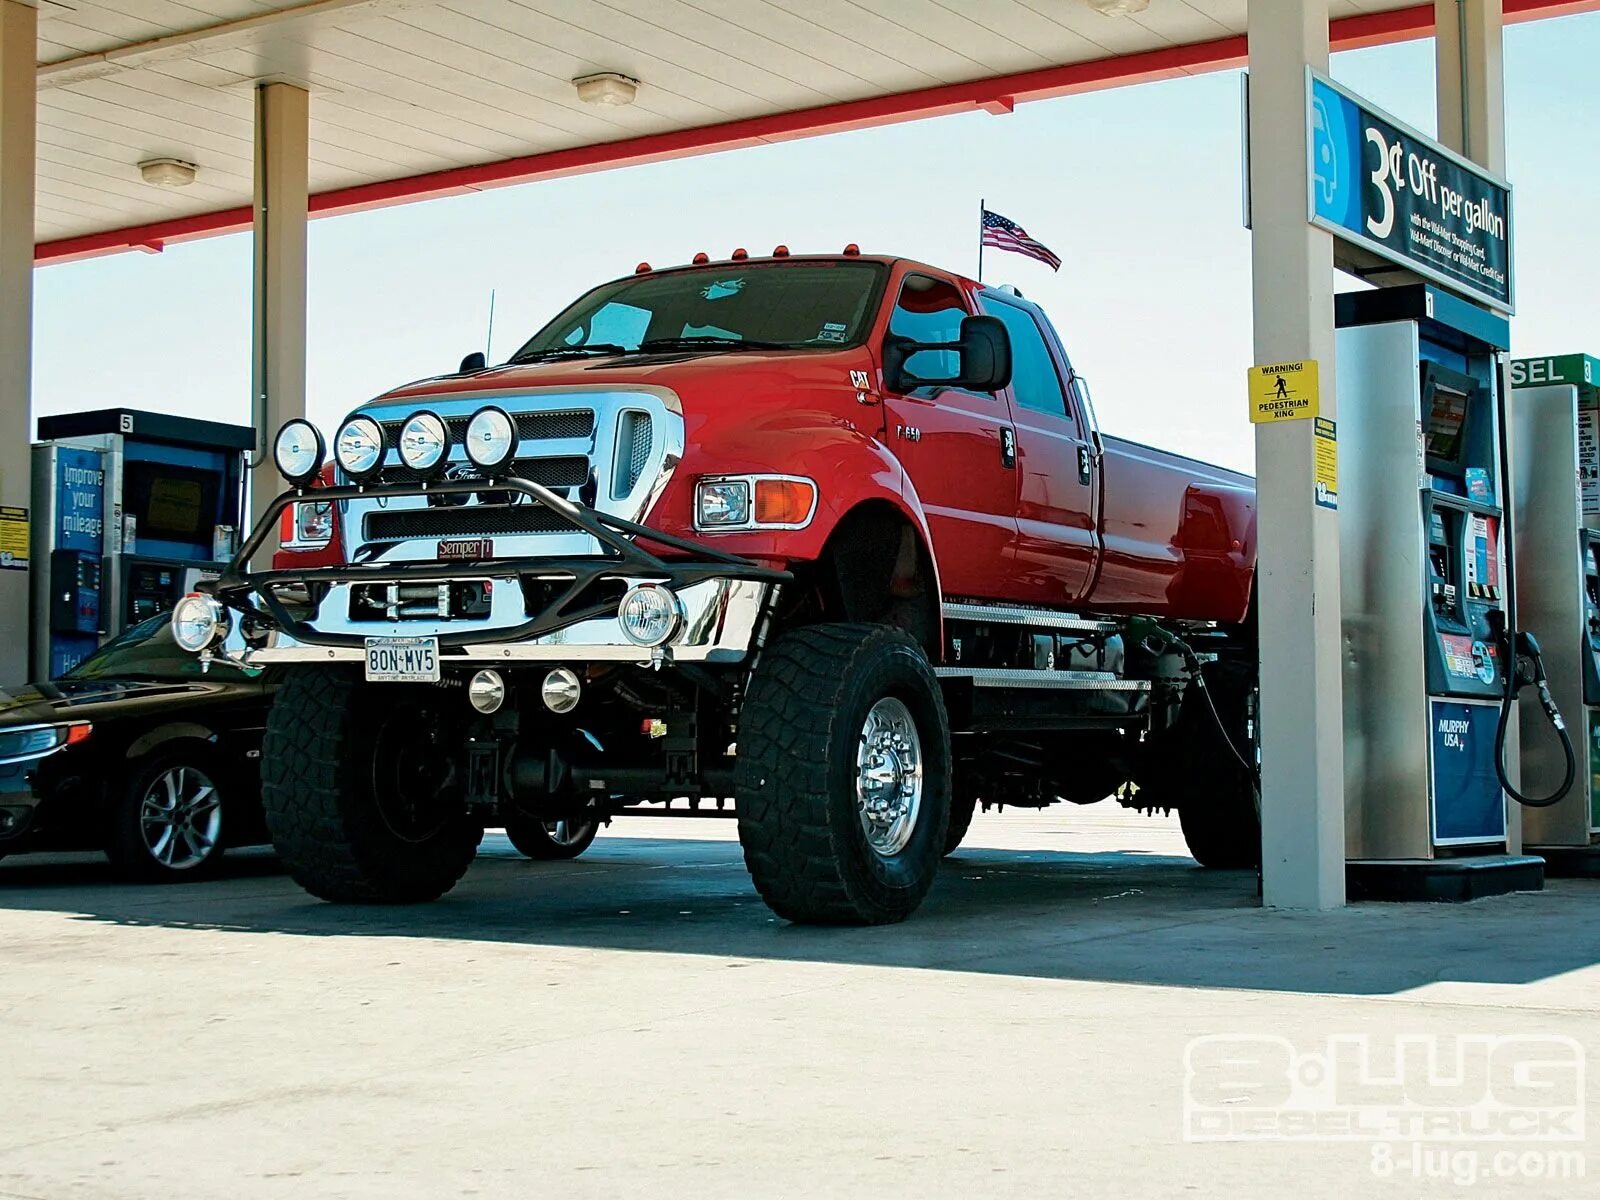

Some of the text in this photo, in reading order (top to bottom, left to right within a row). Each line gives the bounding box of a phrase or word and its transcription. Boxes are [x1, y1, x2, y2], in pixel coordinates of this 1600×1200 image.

[1408, 153, 1437, 205] Off
[1440, 185, 1463, 220] per
[1465, 198, 1504, 240] gallon
[1410, 213, 1421, 226] with
[1422, 218, 1431, 231] the
[1451, 233, 1473, 256] Shopping
[1480, 264, 1495, 279] Credit
[1495, 270, 1504, 284] Card
[1262, 363, 1303, 375] WARNING!
[850, 370, 870, 390] CAT
[1259, 399, 1309, 411] PEDESTRIAN
[1274, 409, 1294, 419] XING
[122, 416, 131, 431] 5
[64, 463, 104, 487] improve
[72, 491, 96, 510] your
[63, 512, 103, 538] mileage
[440, 540, 480, 559] Semper
[1439, 719, 1469, 734] MURPHY
[1444, 734, 1459, 747] USA
